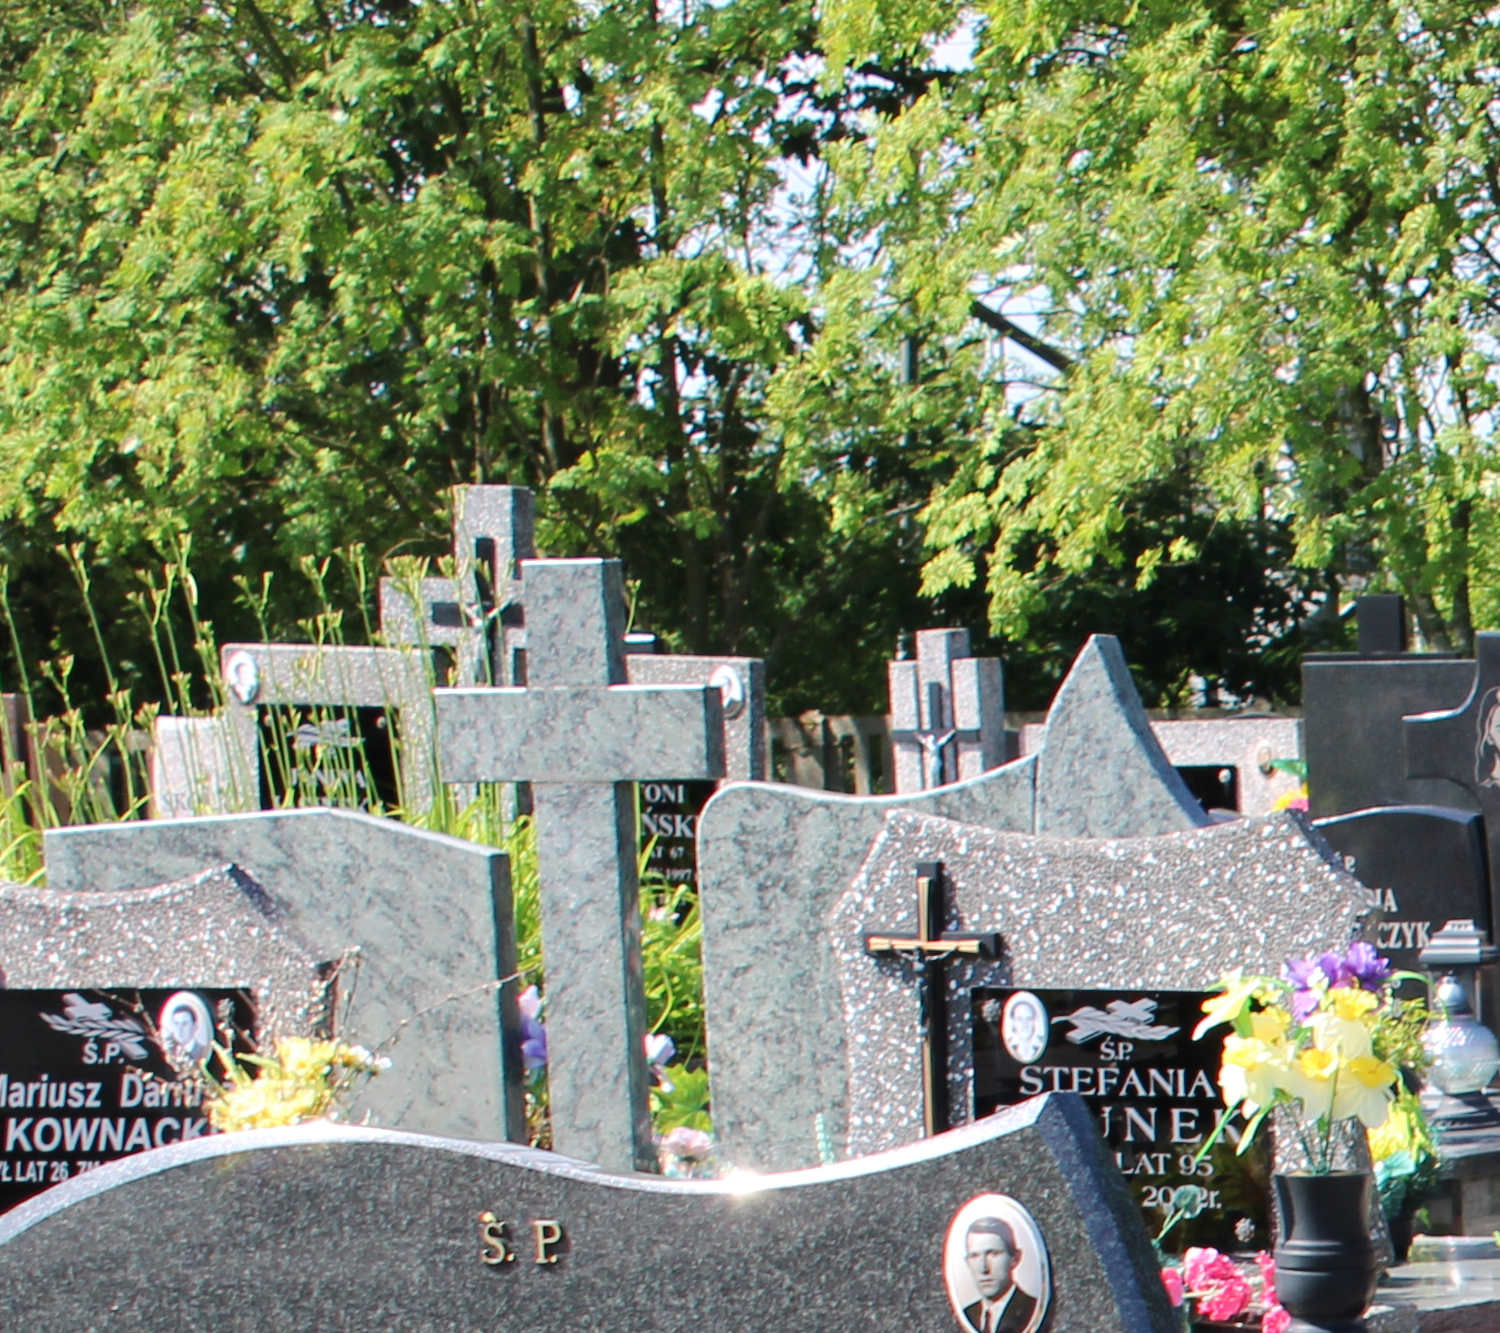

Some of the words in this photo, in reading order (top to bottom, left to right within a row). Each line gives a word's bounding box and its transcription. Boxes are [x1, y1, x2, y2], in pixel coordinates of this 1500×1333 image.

[641, 783, 685, 803] ONI
[640, 806, 694, 838] ŃSK
[1374, 888, 1399, 912] IA
[1376, 922, 1431, 949] CZYK
[82, 1037, 125, 1065] Ś.P.
[0, 1073, 102, 1108] ariusz
[1018, 1065, 1216, 1098] STEFANIA
[5, 1117, 218, 1152] KOWNACK
[15, 1161, 49, 1182] LAT
[50, 1161, 70, 1182] 26
[1115, 1152, 1172, 1176] LAT
[1179, 1154, 1214, 1177] 95
[1142, 1185, 1223, 1210] 202r.
